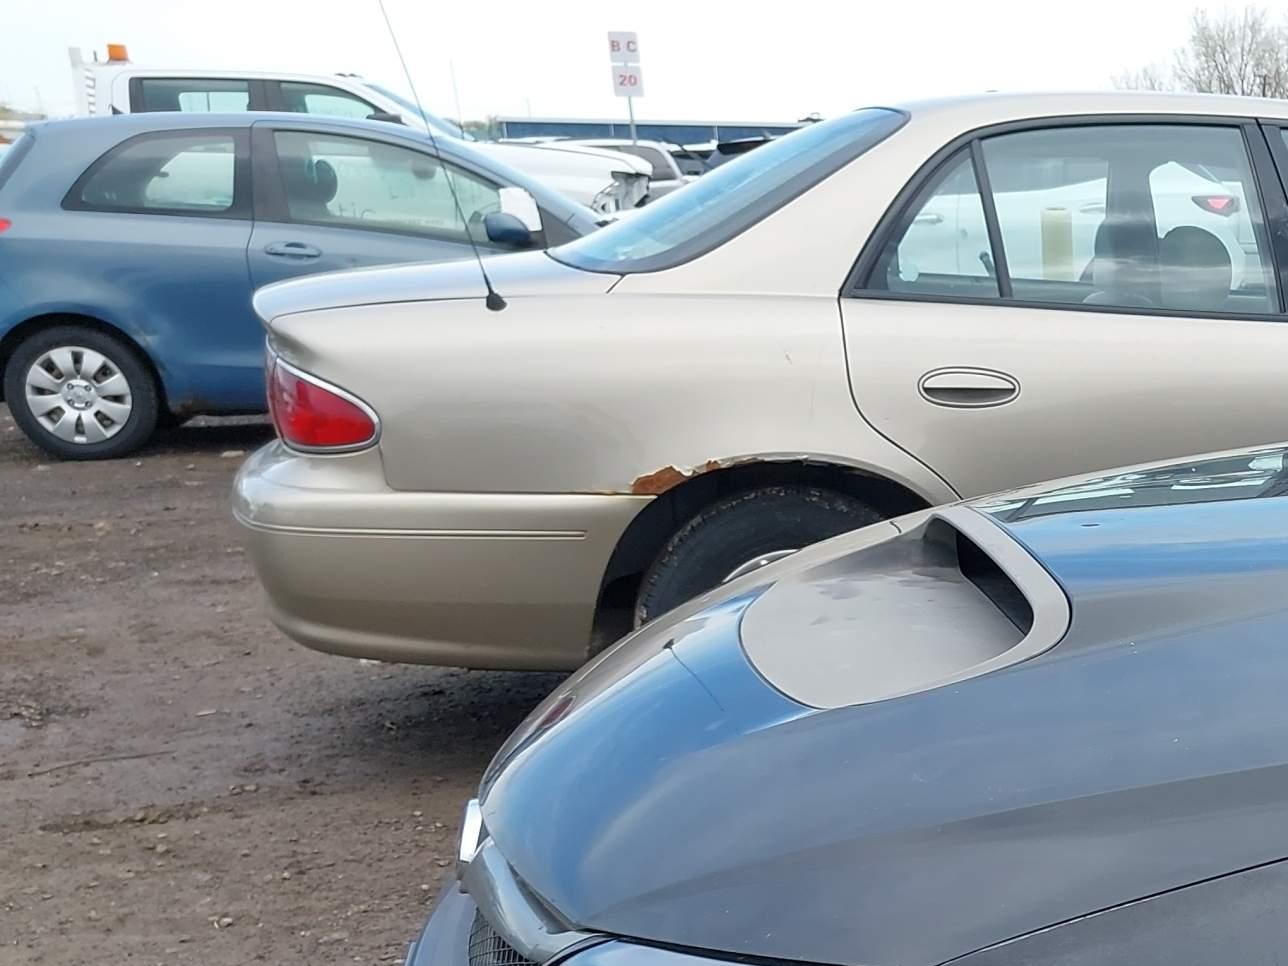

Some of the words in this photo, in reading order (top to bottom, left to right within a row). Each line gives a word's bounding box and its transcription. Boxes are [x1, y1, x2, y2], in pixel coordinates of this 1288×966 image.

[611, 40, 621, 52] B
[627, 40, 637, 52] C
[618, 74, 638, 87] 20
